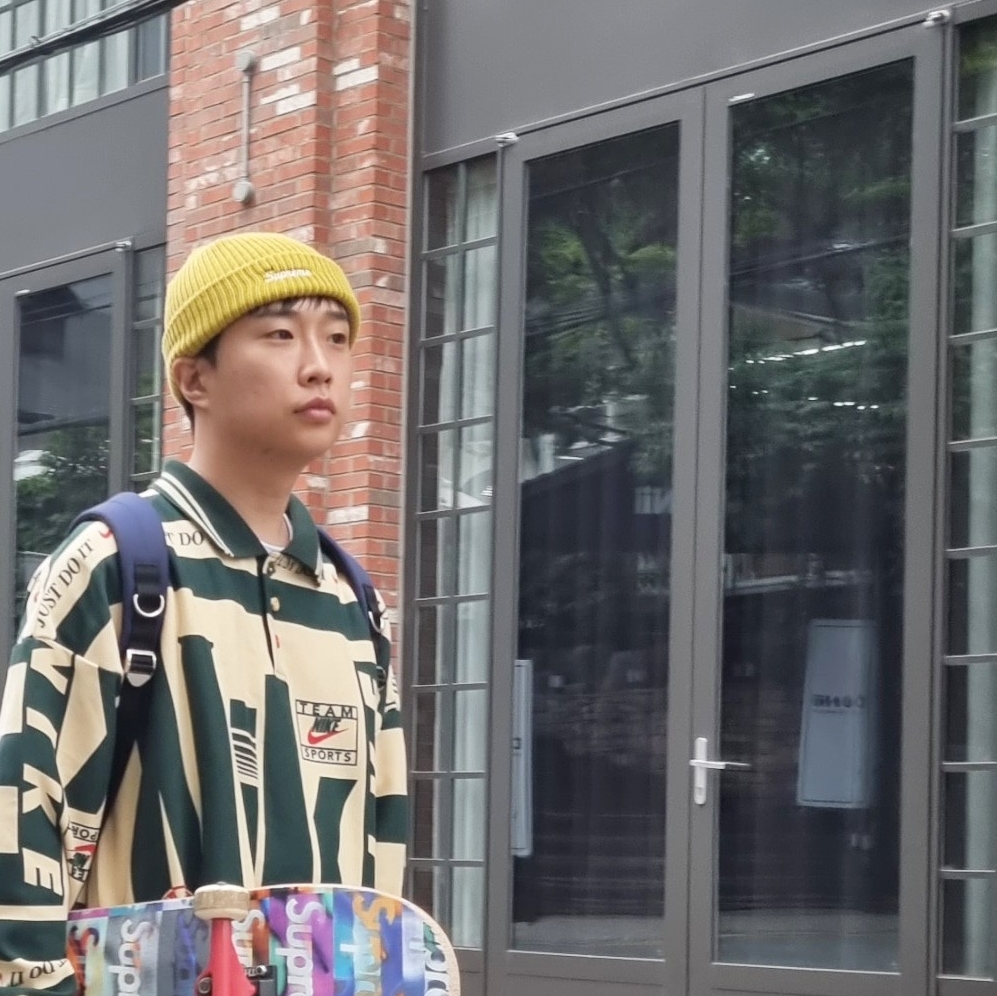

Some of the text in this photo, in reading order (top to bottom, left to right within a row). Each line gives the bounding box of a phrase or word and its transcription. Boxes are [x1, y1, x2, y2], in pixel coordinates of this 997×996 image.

[179, 531, 205, 546] DO
[35, 539, 94, 629] JUST DO IT
[299, 702, 353, 718] TEAM
[304, 747, 352, 762] SPORTS
